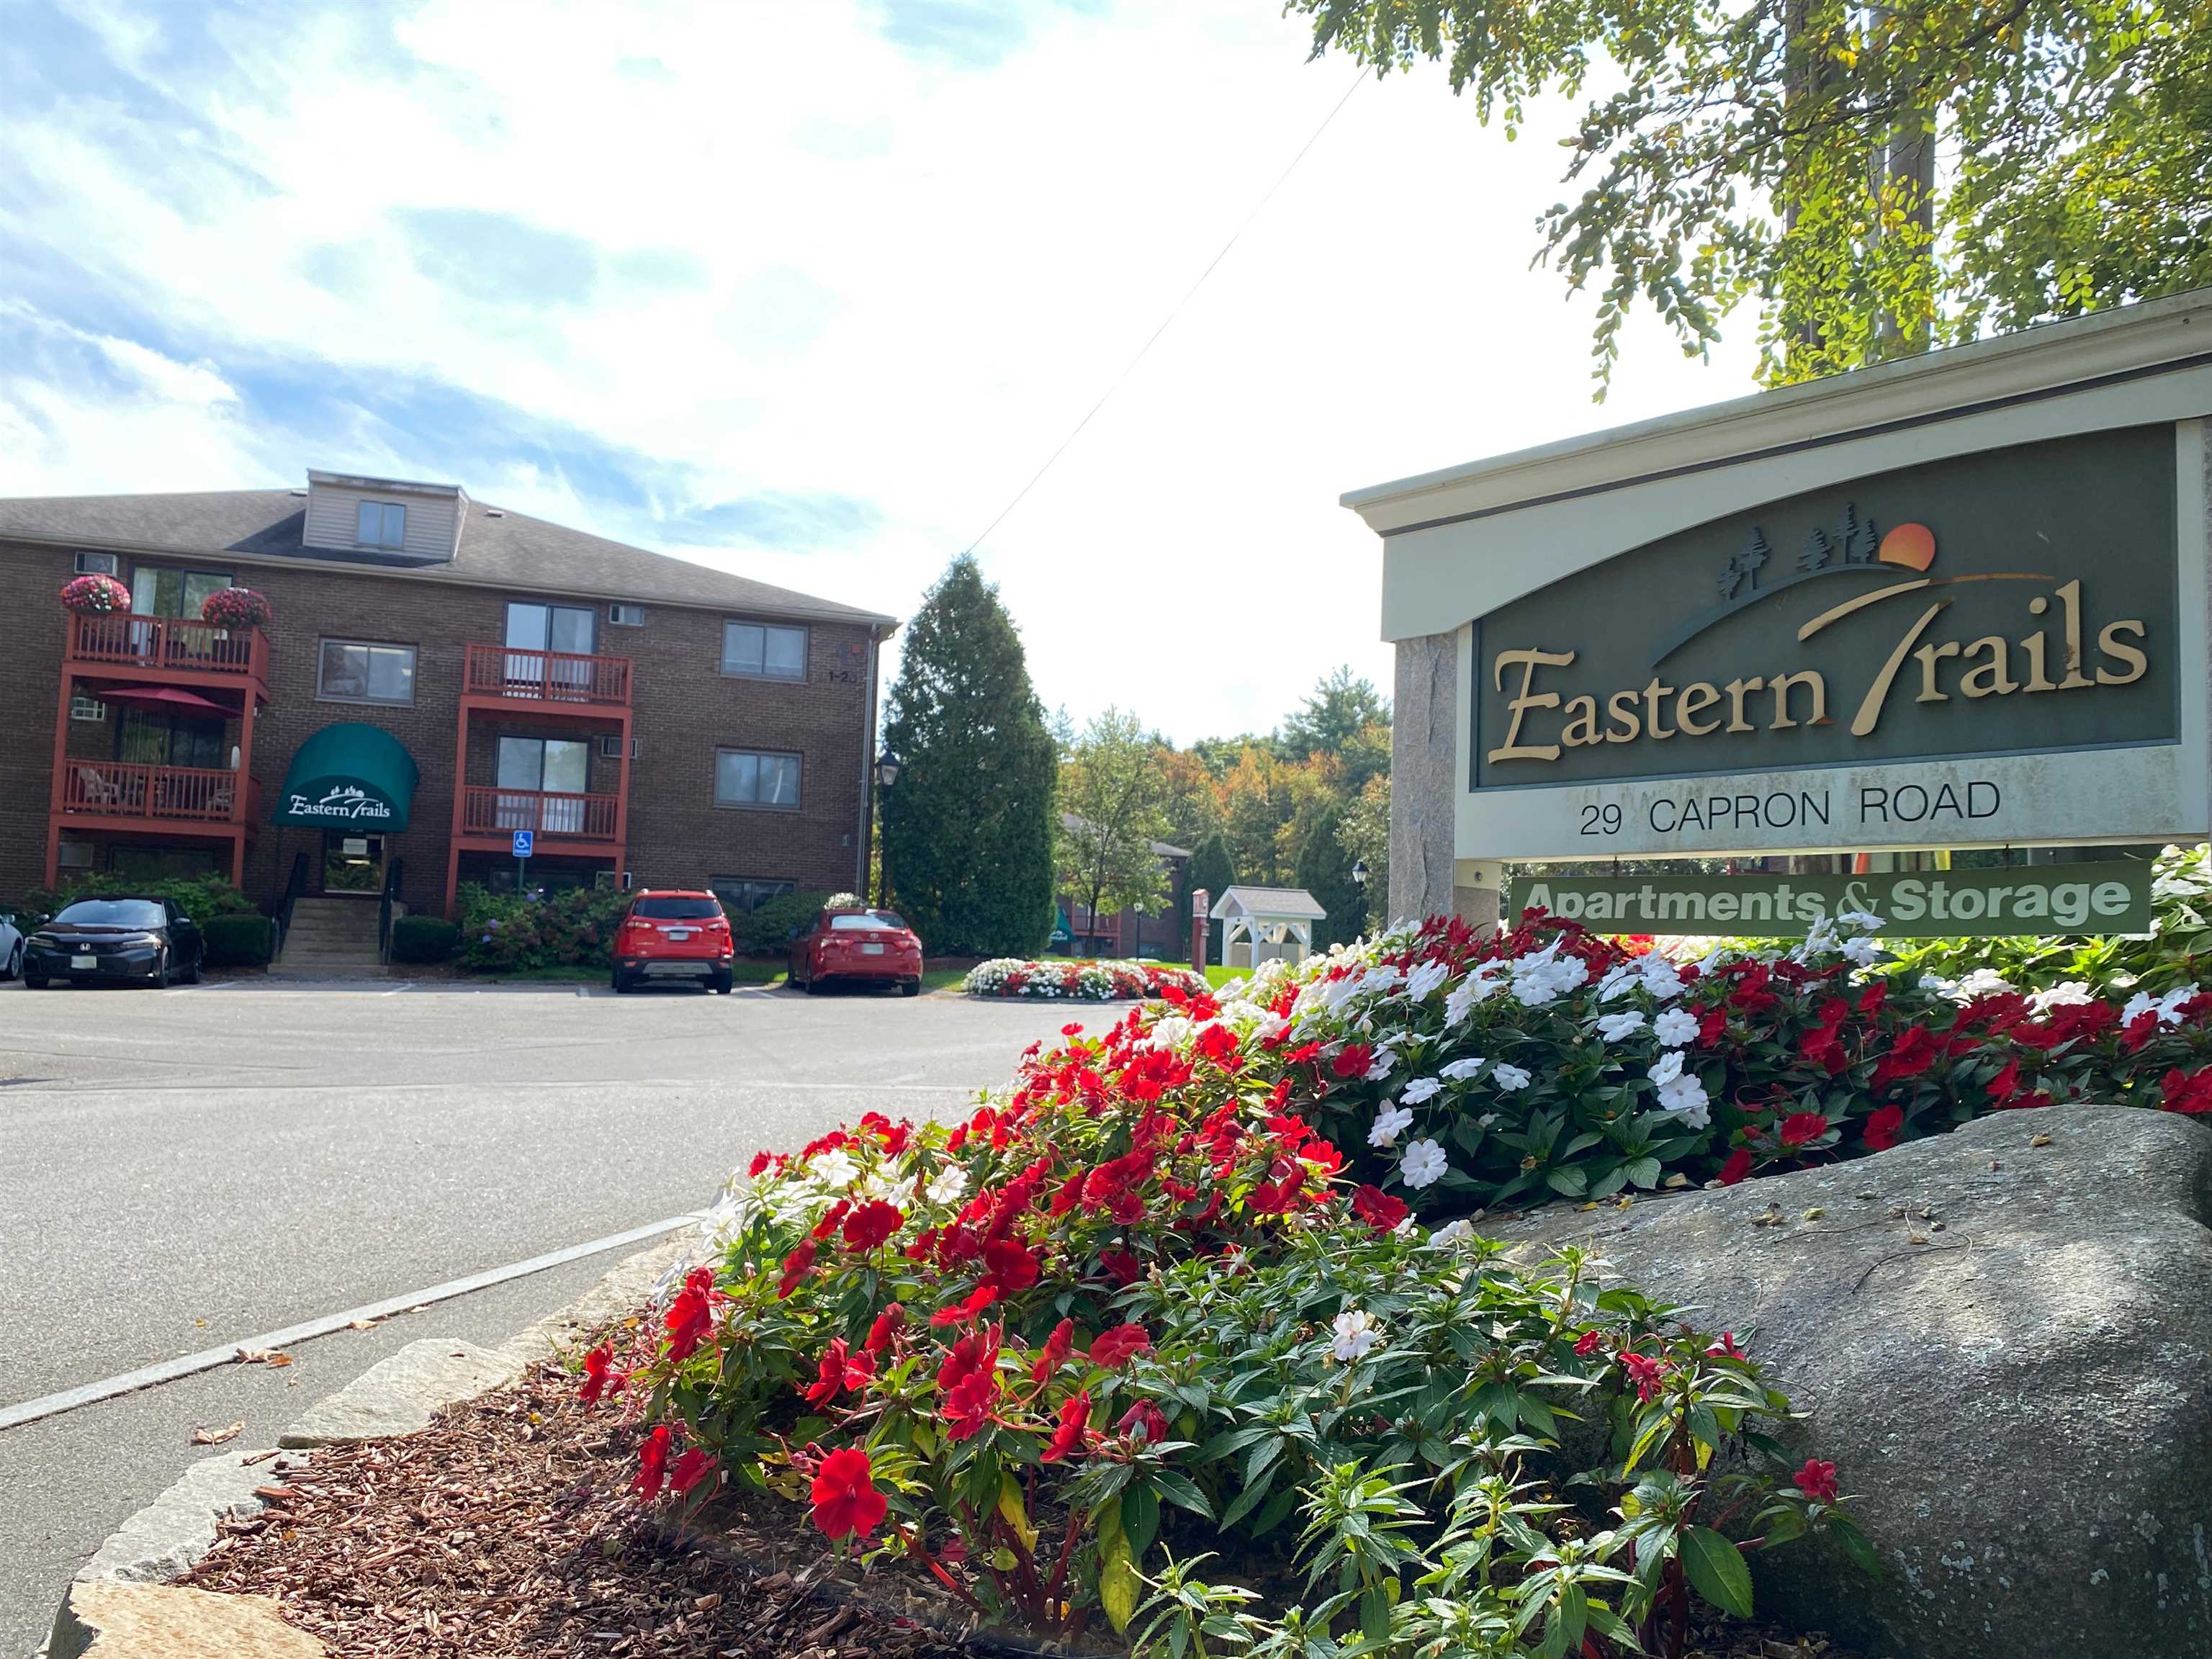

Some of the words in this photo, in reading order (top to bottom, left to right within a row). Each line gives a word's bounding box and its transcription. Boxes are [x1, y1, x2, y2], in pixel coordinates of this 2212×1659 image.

[1488, 647, 1833, 764] Eastern
[1797, 572, 2148, 737] Trails
[289, 794, 349, 817] Eastern
[344, 798, 390, 819] Trails
[1581, 804, 1622, 836] 29
[1650, 791, 1830, 833] CAPRON
[1861, 781, 2000, 823] ROAD
[1524, 883, 1826, 921] Apartments
[1890, 878, 2132, 927] Storage
